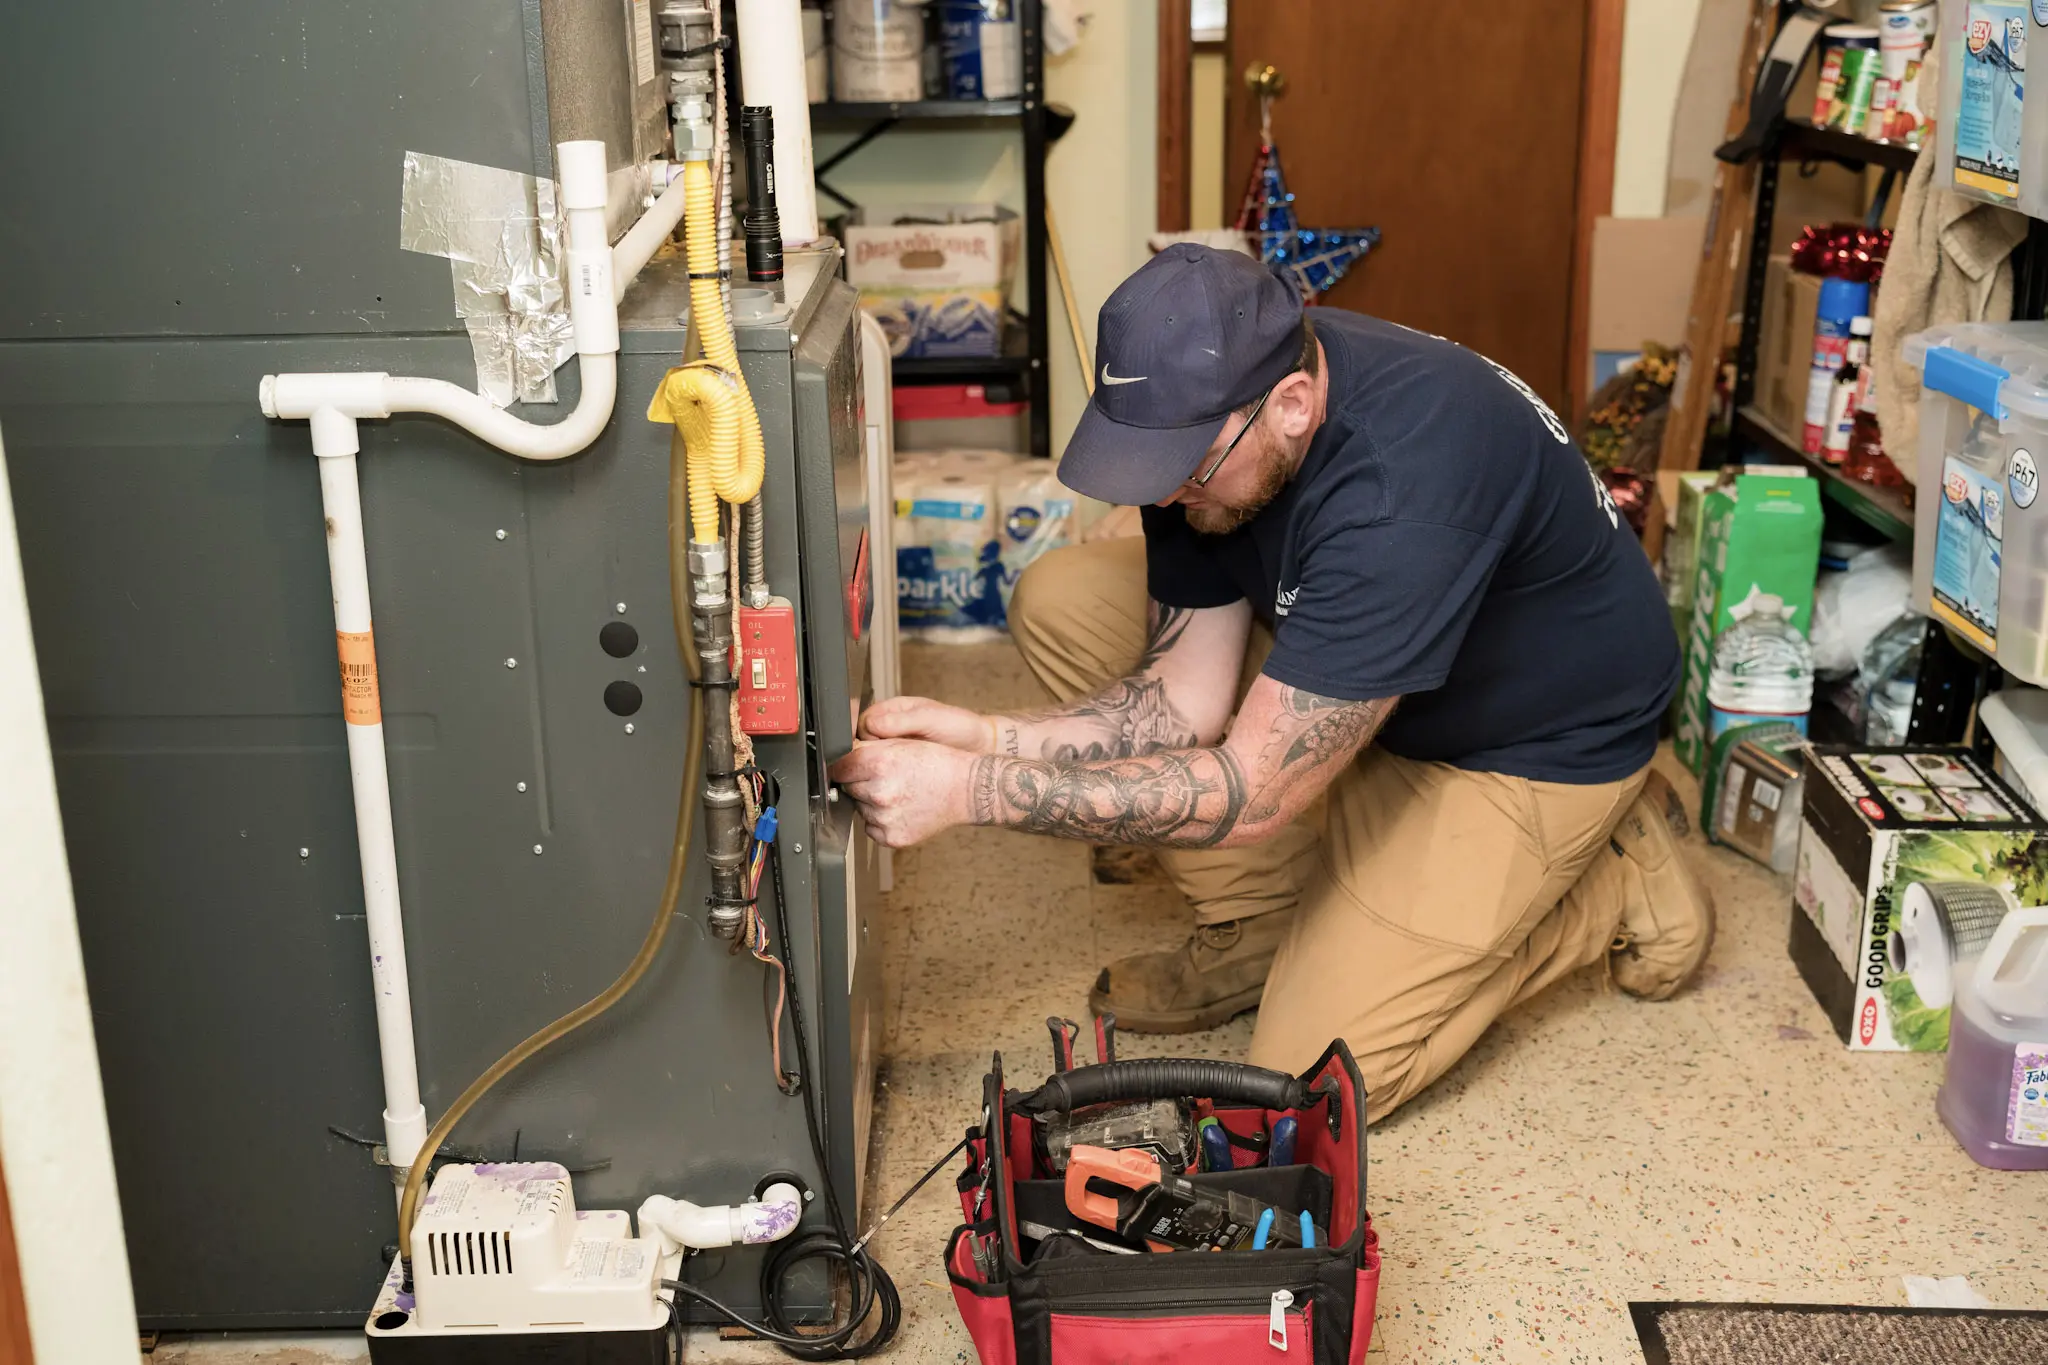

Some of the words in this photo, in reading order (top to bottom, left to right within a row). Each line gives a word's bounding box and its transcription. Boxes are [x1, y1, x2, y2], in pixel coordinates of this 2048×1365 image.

[766, 163, 774, 194] NEBO
[2012, 460, 2036, 487] IP67
[898, 573, 985, 608] parkle
[743, 647, 776, 656] URNER
[740, 695, 787, 703] MERGENCY
[769, 682, 788, 690] OFF
[1871, 885, 1893, 937] GRIPS
[1866, 939, 1887, 989] GOOD
[1862, 1005, 1876, 1038] OXO
